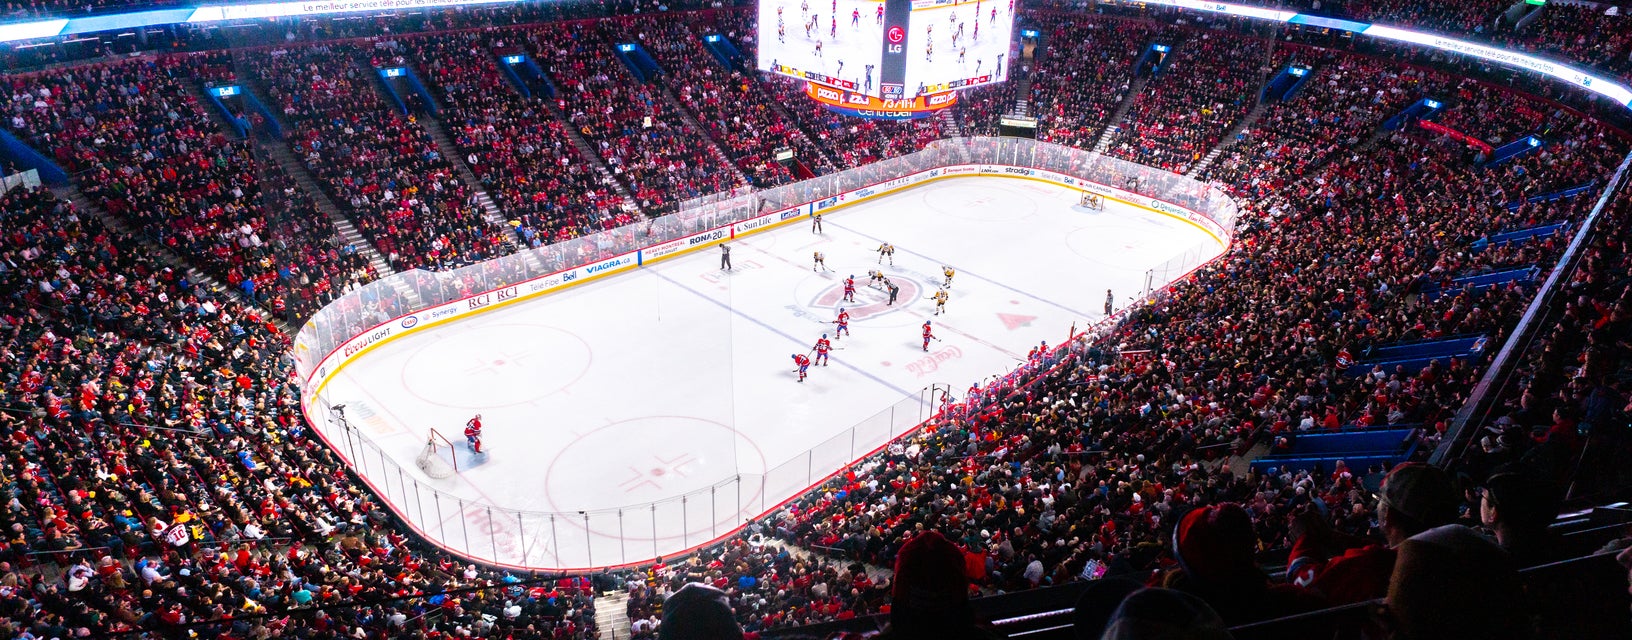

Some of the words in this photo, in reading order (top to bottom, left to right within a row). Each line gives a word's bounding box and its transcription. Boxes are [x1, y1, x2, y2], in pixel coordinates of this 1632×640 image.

[316, 3, 347, 11] meilleur
[350, 1, 378, 9] service
[888, 44, 902, 53] LG
[1160, 203, 1187, 217] Desjardins
[744, 221, 758, 230] Sun
[759, 216, 772, 226] Life
[689, 233, 712, 245] RONA
[563, 270, 577, 282] Bell
[468, 294, 490, 308] RCI
[497, 286, 518, 301] RCI
[432, 305, 458, 318] Synergy
[367, 327, 391, 344] LIGHT
[173, 529, 186, 542] 10
